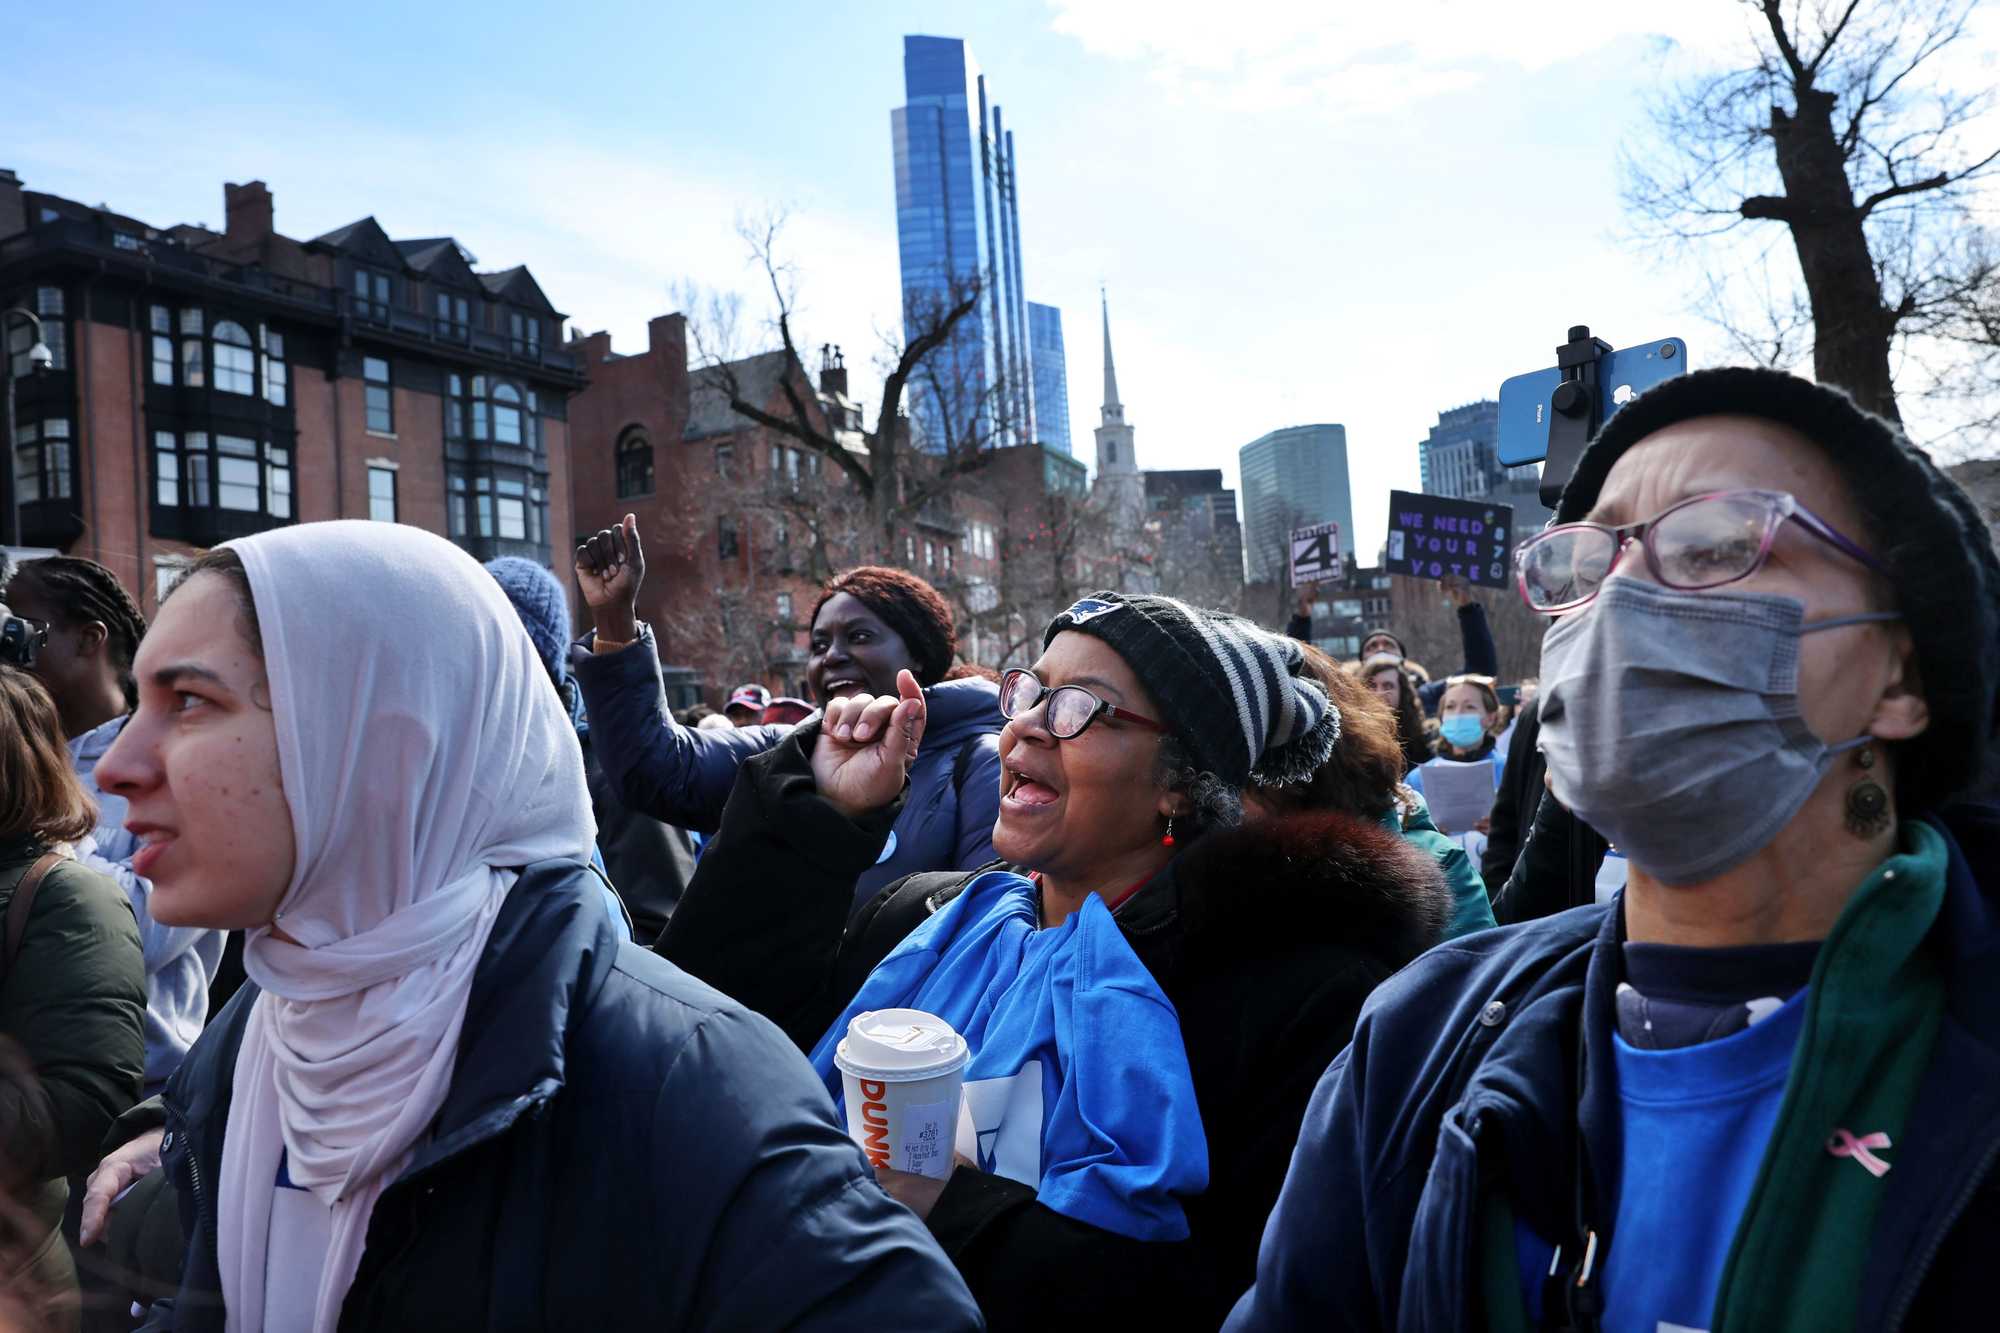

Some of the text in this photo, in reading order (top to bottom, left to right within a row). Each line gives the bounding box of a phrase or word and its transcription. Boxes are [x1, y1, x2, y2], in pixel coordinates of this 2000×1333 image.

[1400, 512, 1483, 535] WE NEED
[1294, 532, 1338, 569] 4
[1413, 533, 1478, 557] YOUR
[1411, 559, 1480, 581] VOTE
